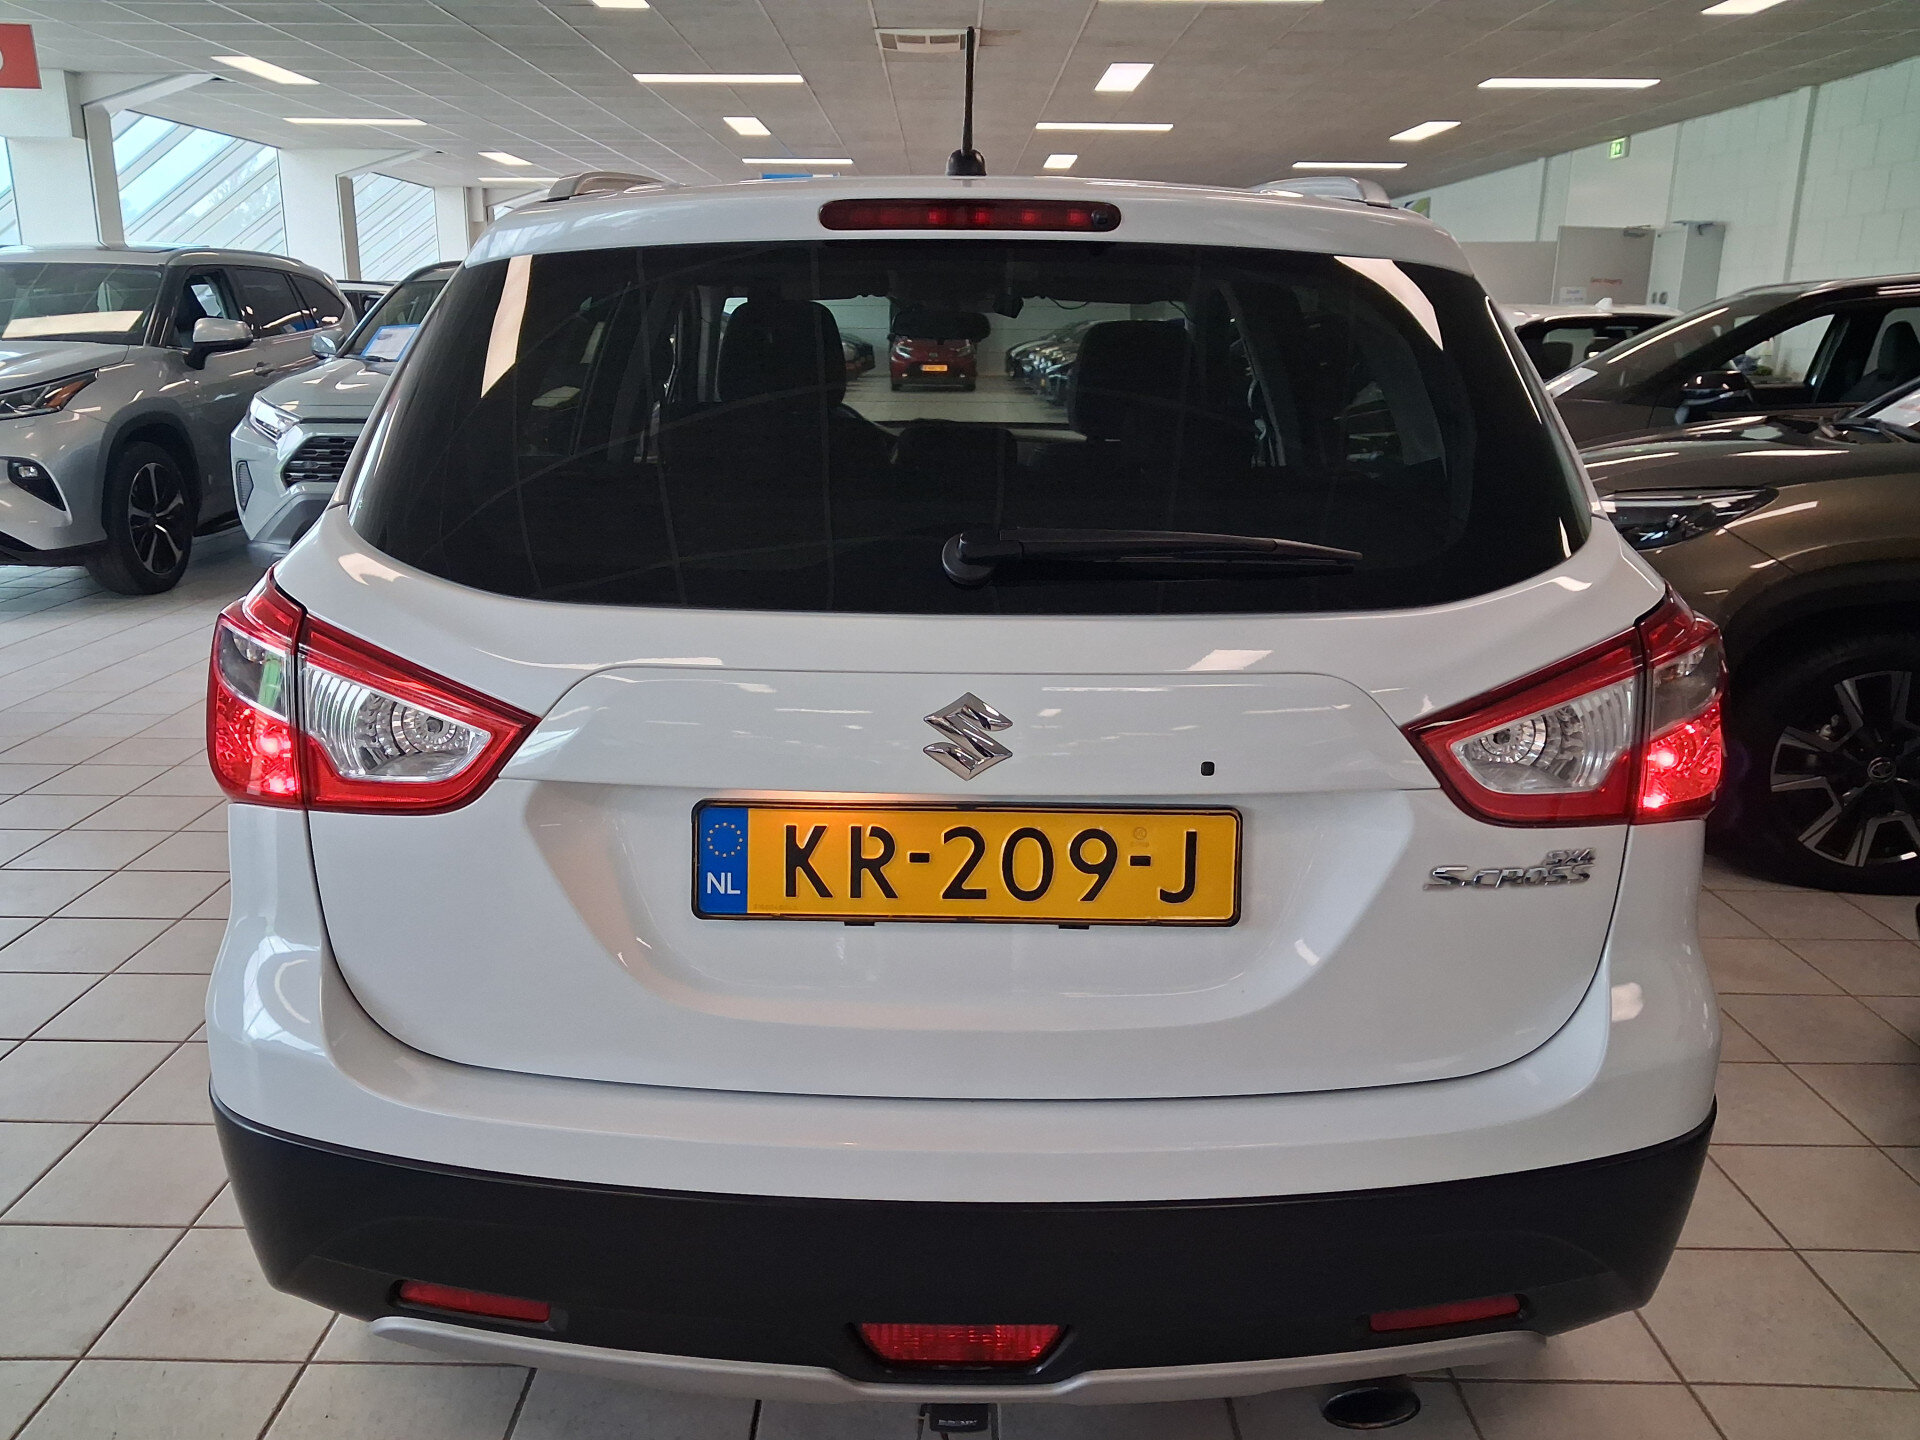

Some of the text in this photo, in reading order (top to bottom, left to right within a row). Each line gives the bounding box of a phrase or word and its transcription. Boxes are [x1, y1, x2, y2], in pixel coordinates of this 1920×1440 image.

[785, 824, 1198, 904] KR-209-J
[1544, 848, 1596, 866] SX4
[706, 872, 741, 895] NL
